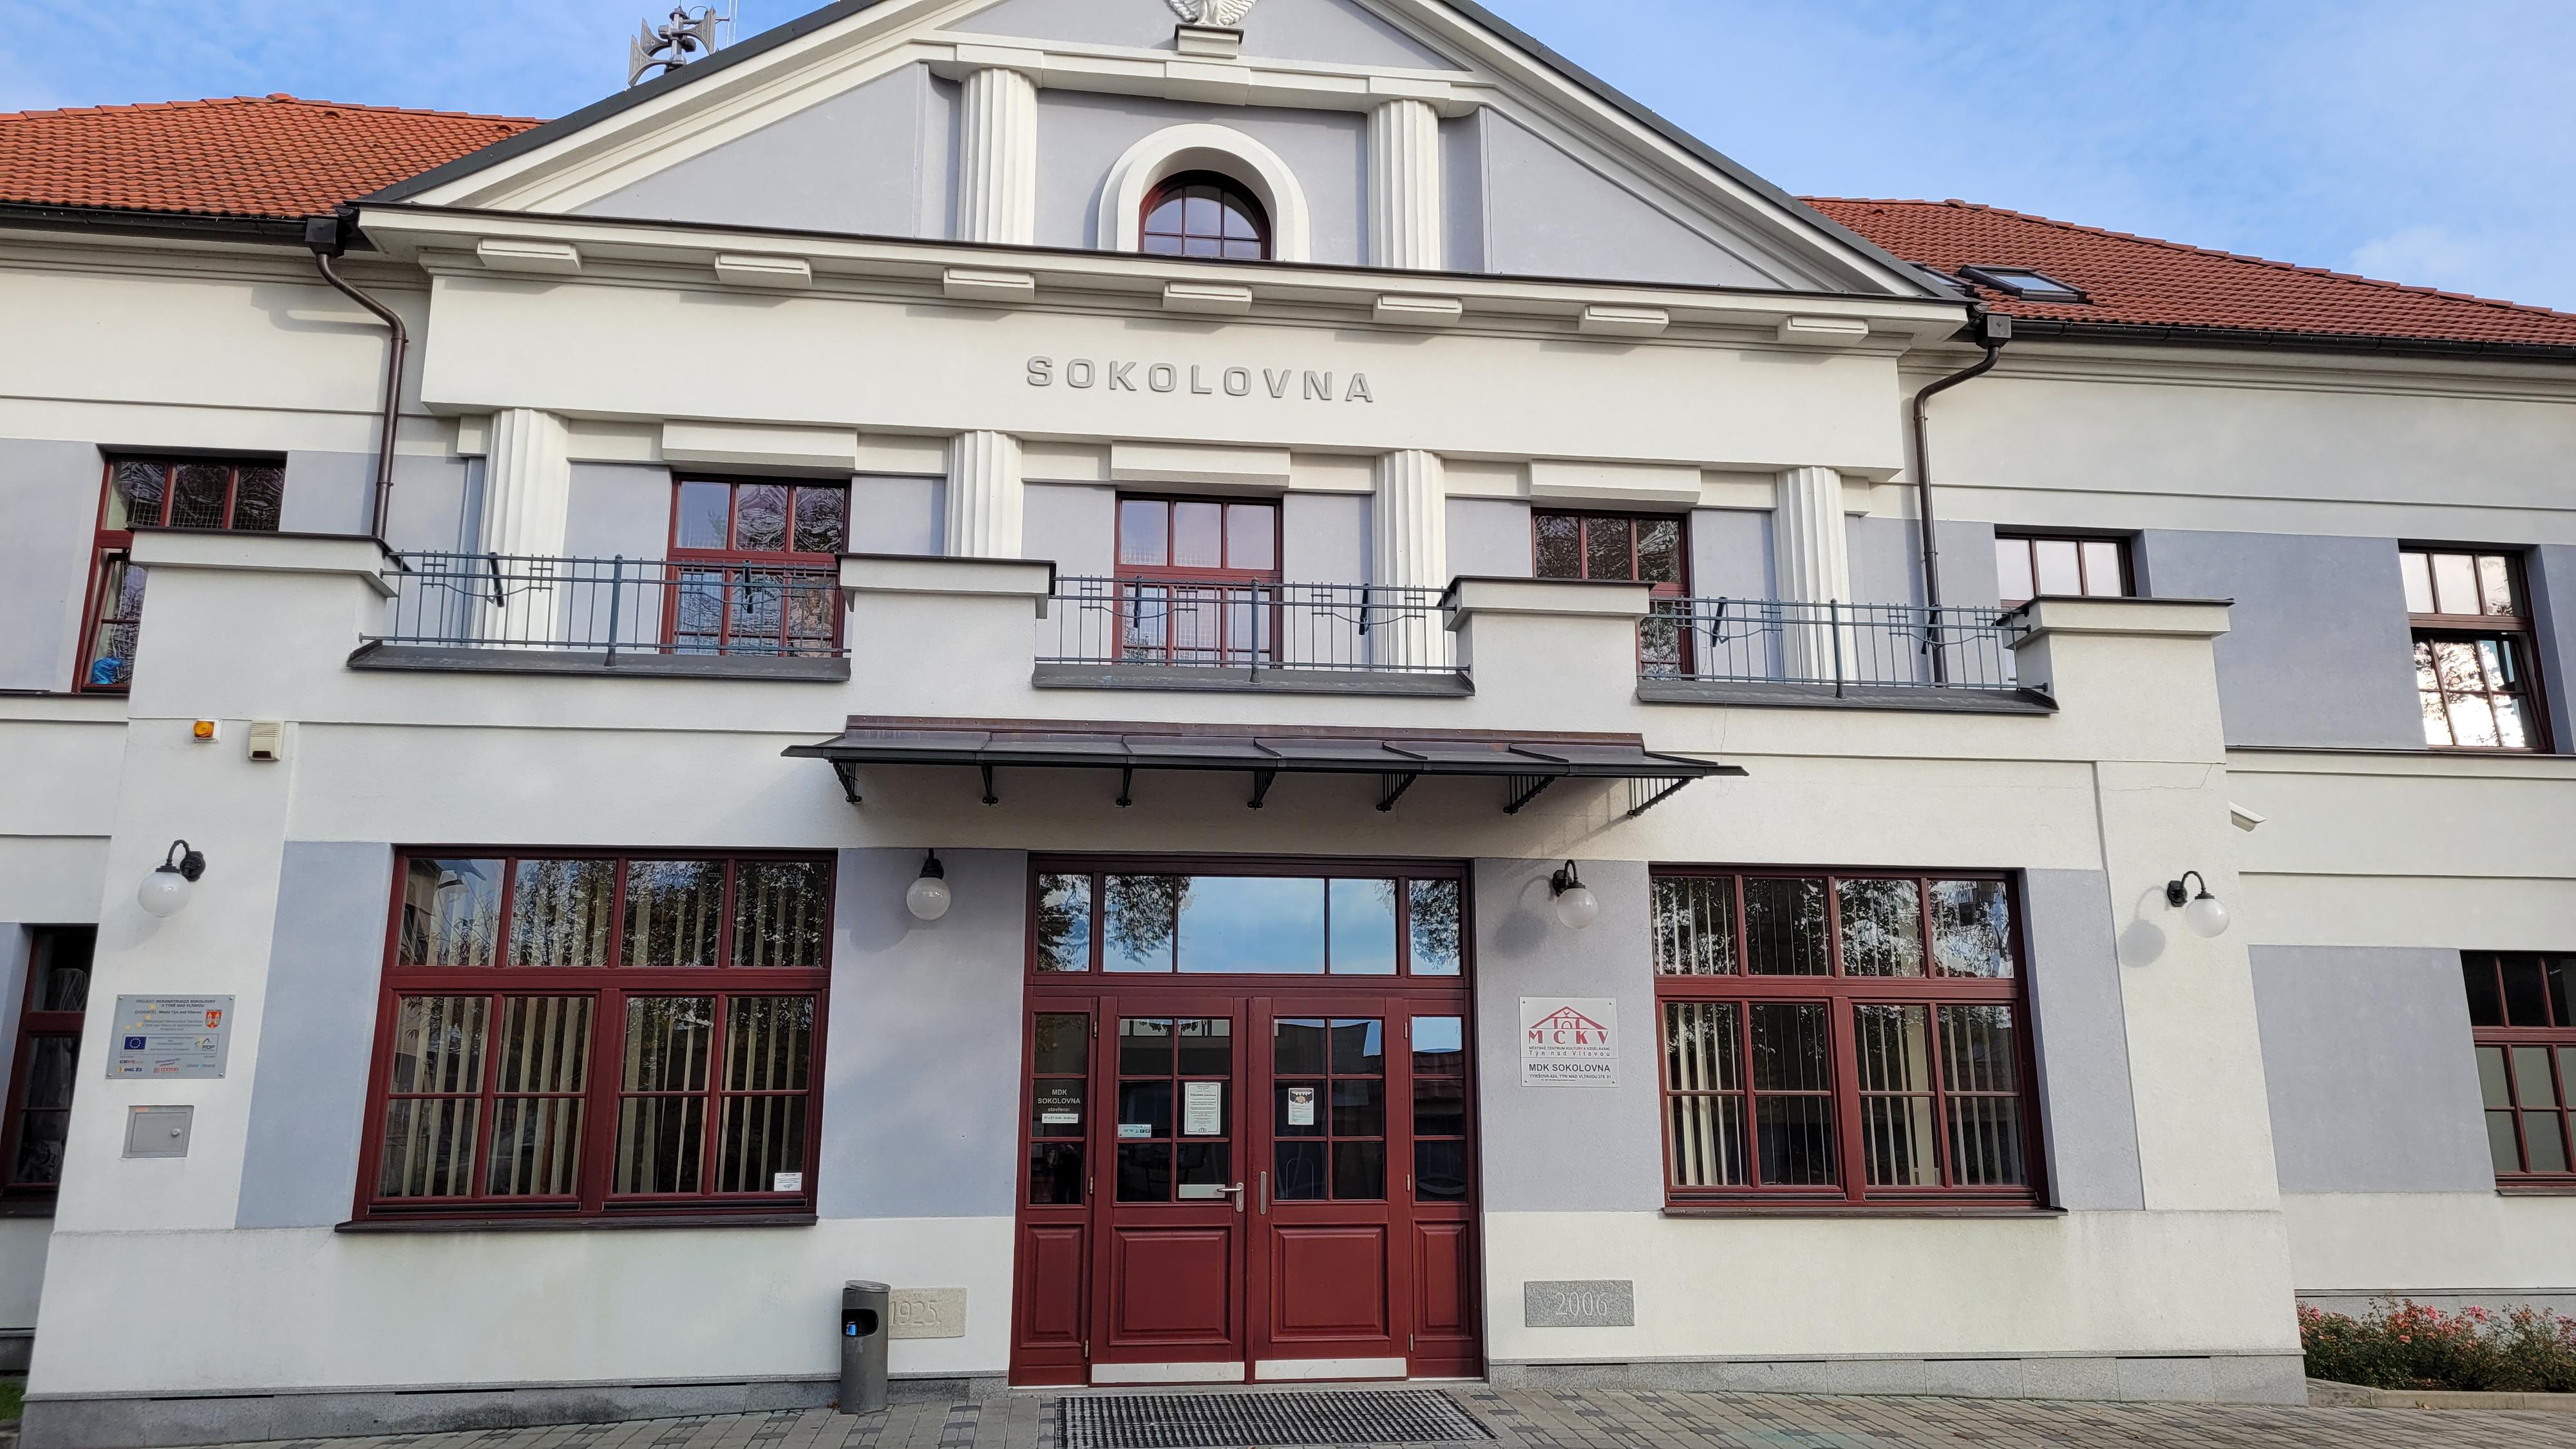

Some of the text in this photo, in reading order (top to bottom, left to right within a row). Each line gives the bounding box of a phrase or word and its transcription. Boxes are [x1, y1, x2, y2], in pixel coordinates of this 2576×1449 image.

[1027, 355, 1374, 402] SOKOLOVNA
[1551, 1064, 1611, 1072] SOKOLOVNA
[1555, 1292, 1608, 1316] 2006
